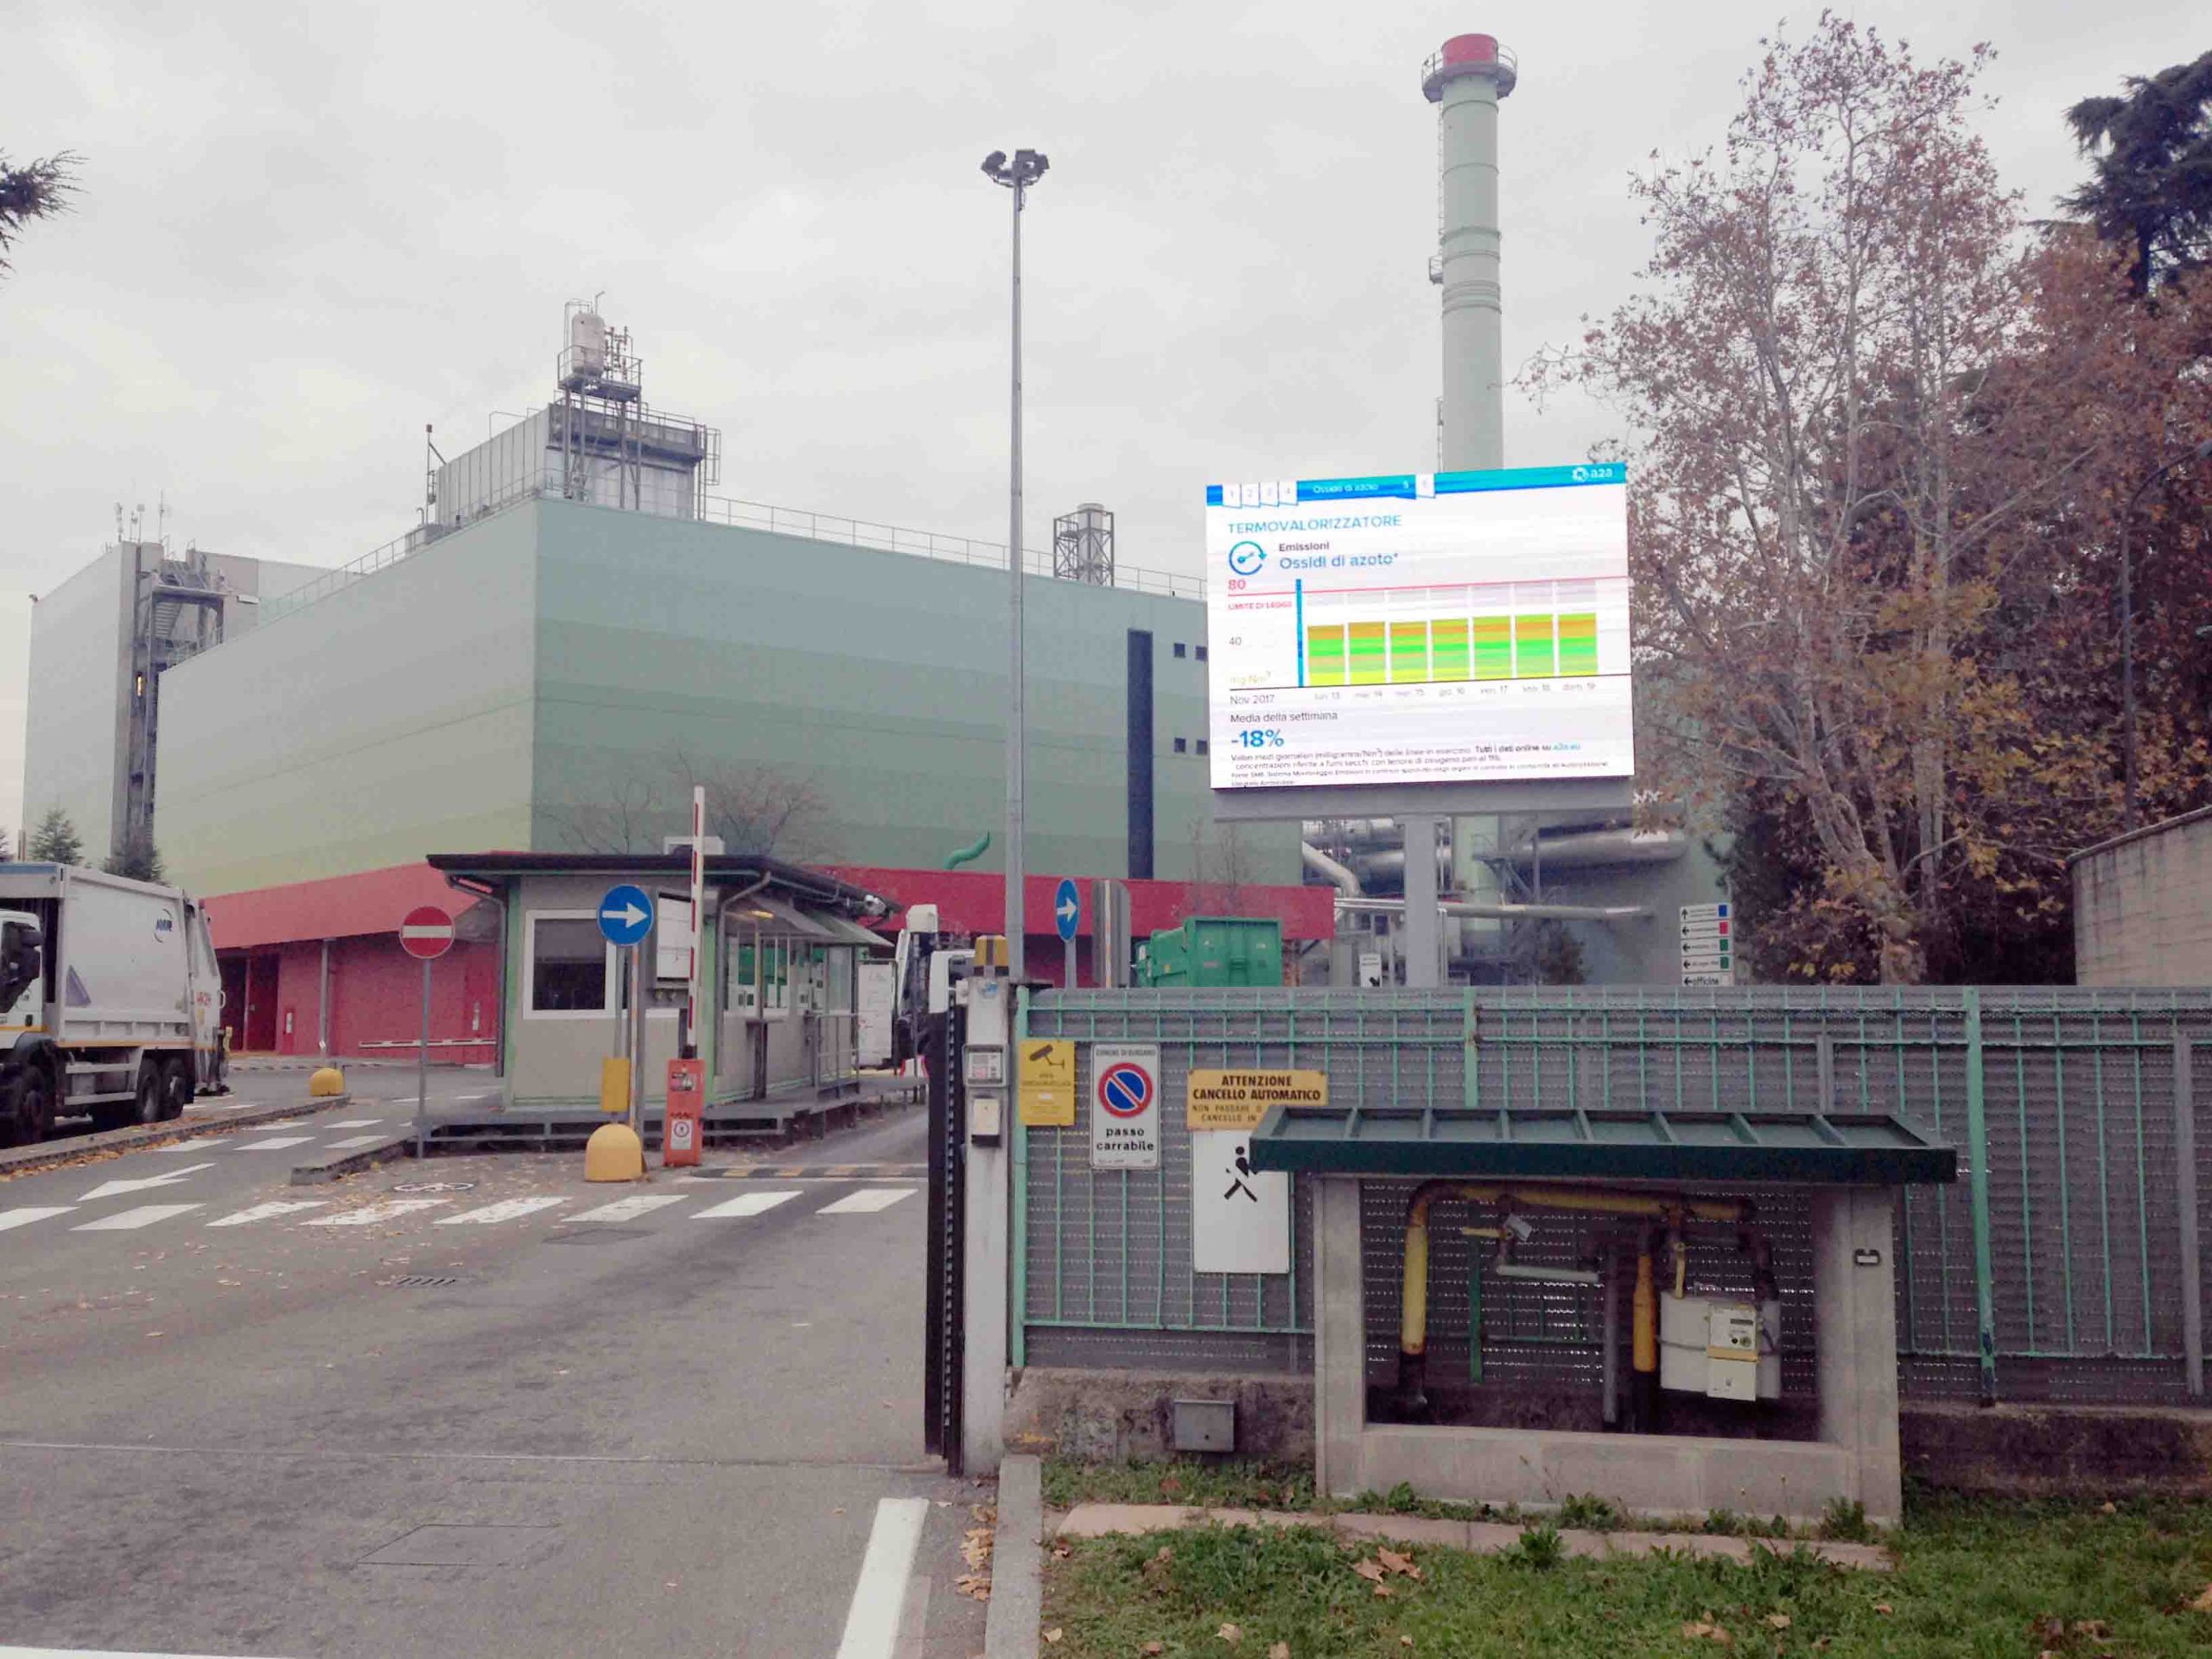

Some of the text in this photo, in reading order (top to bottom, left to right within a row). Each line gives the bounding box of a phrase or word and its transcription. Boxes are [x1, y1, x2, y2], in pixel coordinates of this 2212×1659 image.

[1228, 515, 1402, 534] TERMOVALORIZZATORE
[1279, 542, 1330, 552] Emissioni
[1279, 556, 1327, 569] Ossidi
[1332, 555, 1345, 568] di
[1228, 579, 1246, 590] 80
[1229, 637, 1243, 646] 40
[1230, 696, 1249, 705] Nov
[1253, 694, 1275, 703] 2017
[1230, 710, 1338, 723] Media della settimana
[1230, 728, 1285, 748] -18%
[1222, 1075, 1293, 1087] ATTENZIONE
[1192, 1089, 1321, 1101] CANCELLO AUTOMATICO
[1106, 1128, 1145, 1139] passo
[1096, 1140, 1154, 1151] carrabile
